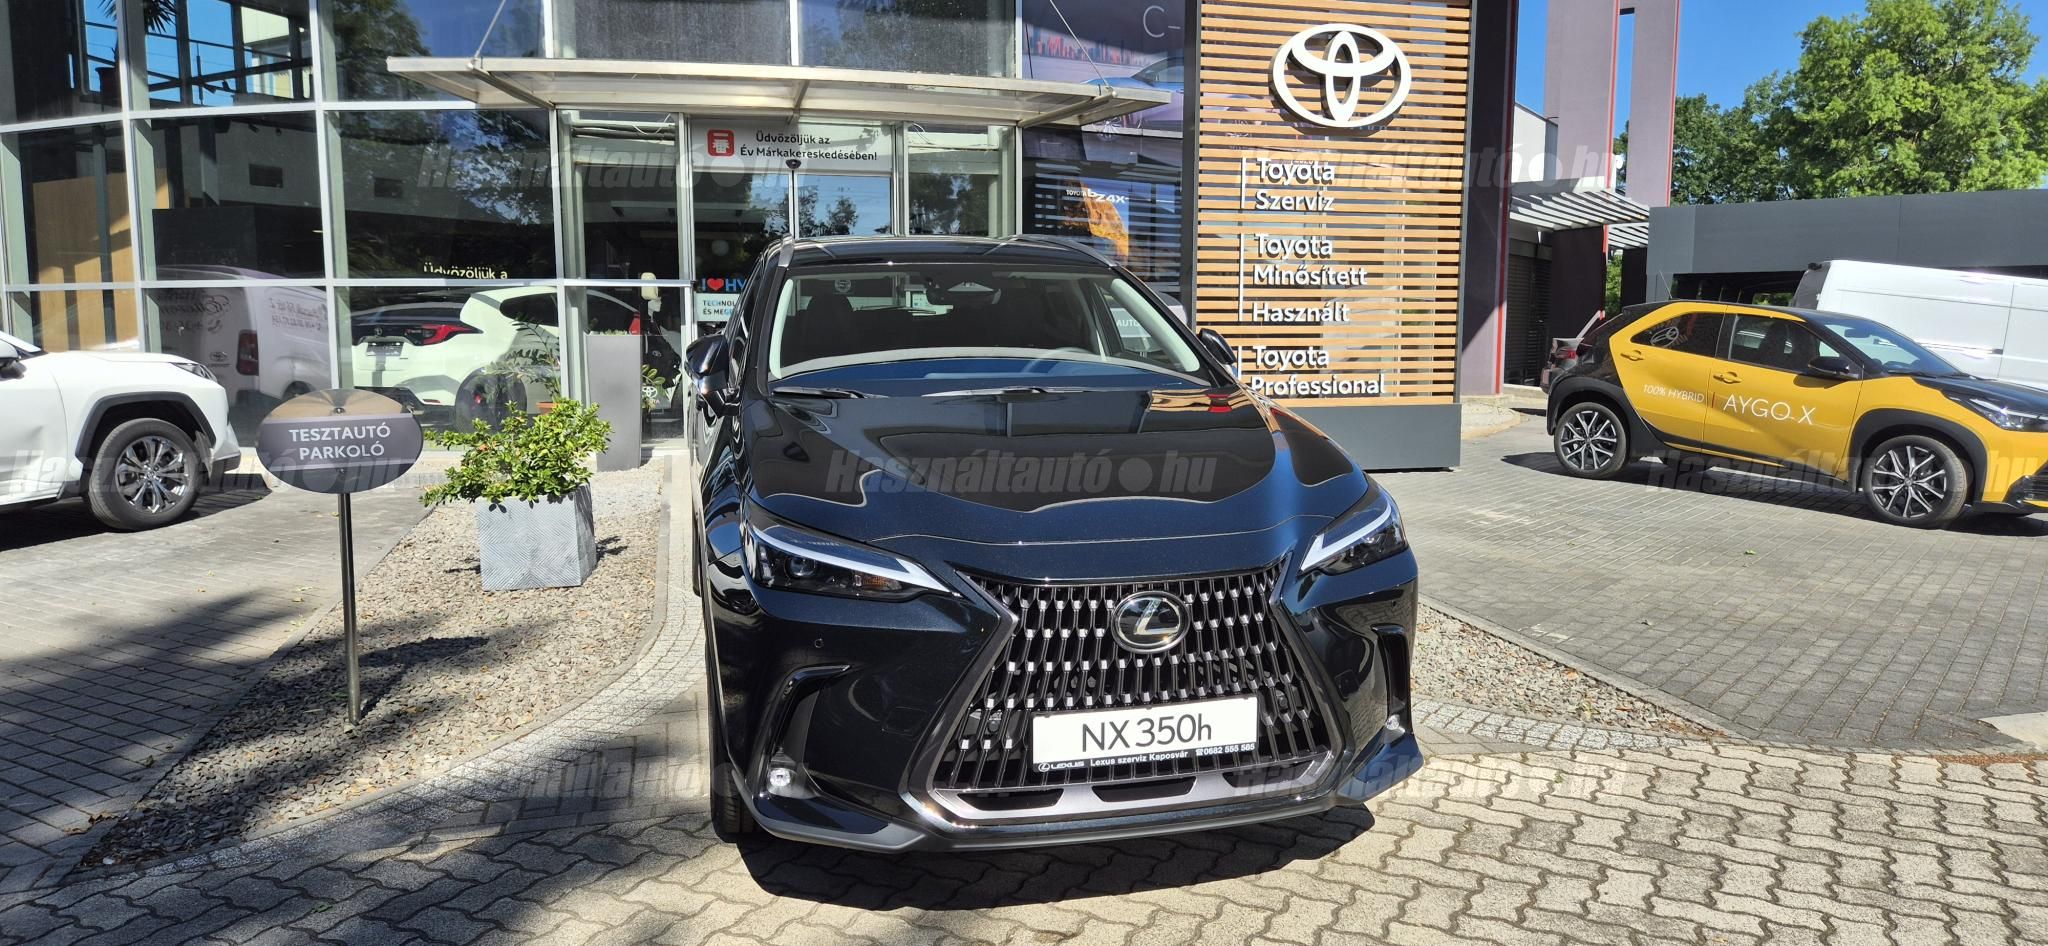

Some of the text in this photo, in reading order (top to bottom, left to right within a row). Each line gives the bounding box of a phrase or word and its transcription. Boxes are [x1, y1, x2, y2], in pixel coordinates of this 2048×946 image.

[756, 130, 831, 146] Üdvözöljük az
[740, 144, 877, 161] Év Márkakereskedésében!
[1255, 157, 1336, 186] Toyota
[1255, 190, 1335, 212] Szerviz
[1253, 233, 1334, 261] Toyota
[1253, 264, 1368, 286] Minősített
[1252, 301, 1351, 322] Használt
[1252, 345, 1330, 371] Toyota
[1251, 374, 1388, 396] Professional
[1643, 384, 1705, 403] 100% HYBRID
[288, 421, 391, 442] TESZTAUTÓ
[299, 441, 385, 461] PARKOLÓ
[1082, 713, 1212, 752] NX 350h
[1050, 761, 1085, 769] LEXUS
[1090, 758, 1115, 767] Lexus
[1117, 754, 1147, 764] szerviz
[1149, 751, 1189, 762] Kaposvár
[1224, 745, 1239, 753] 555
